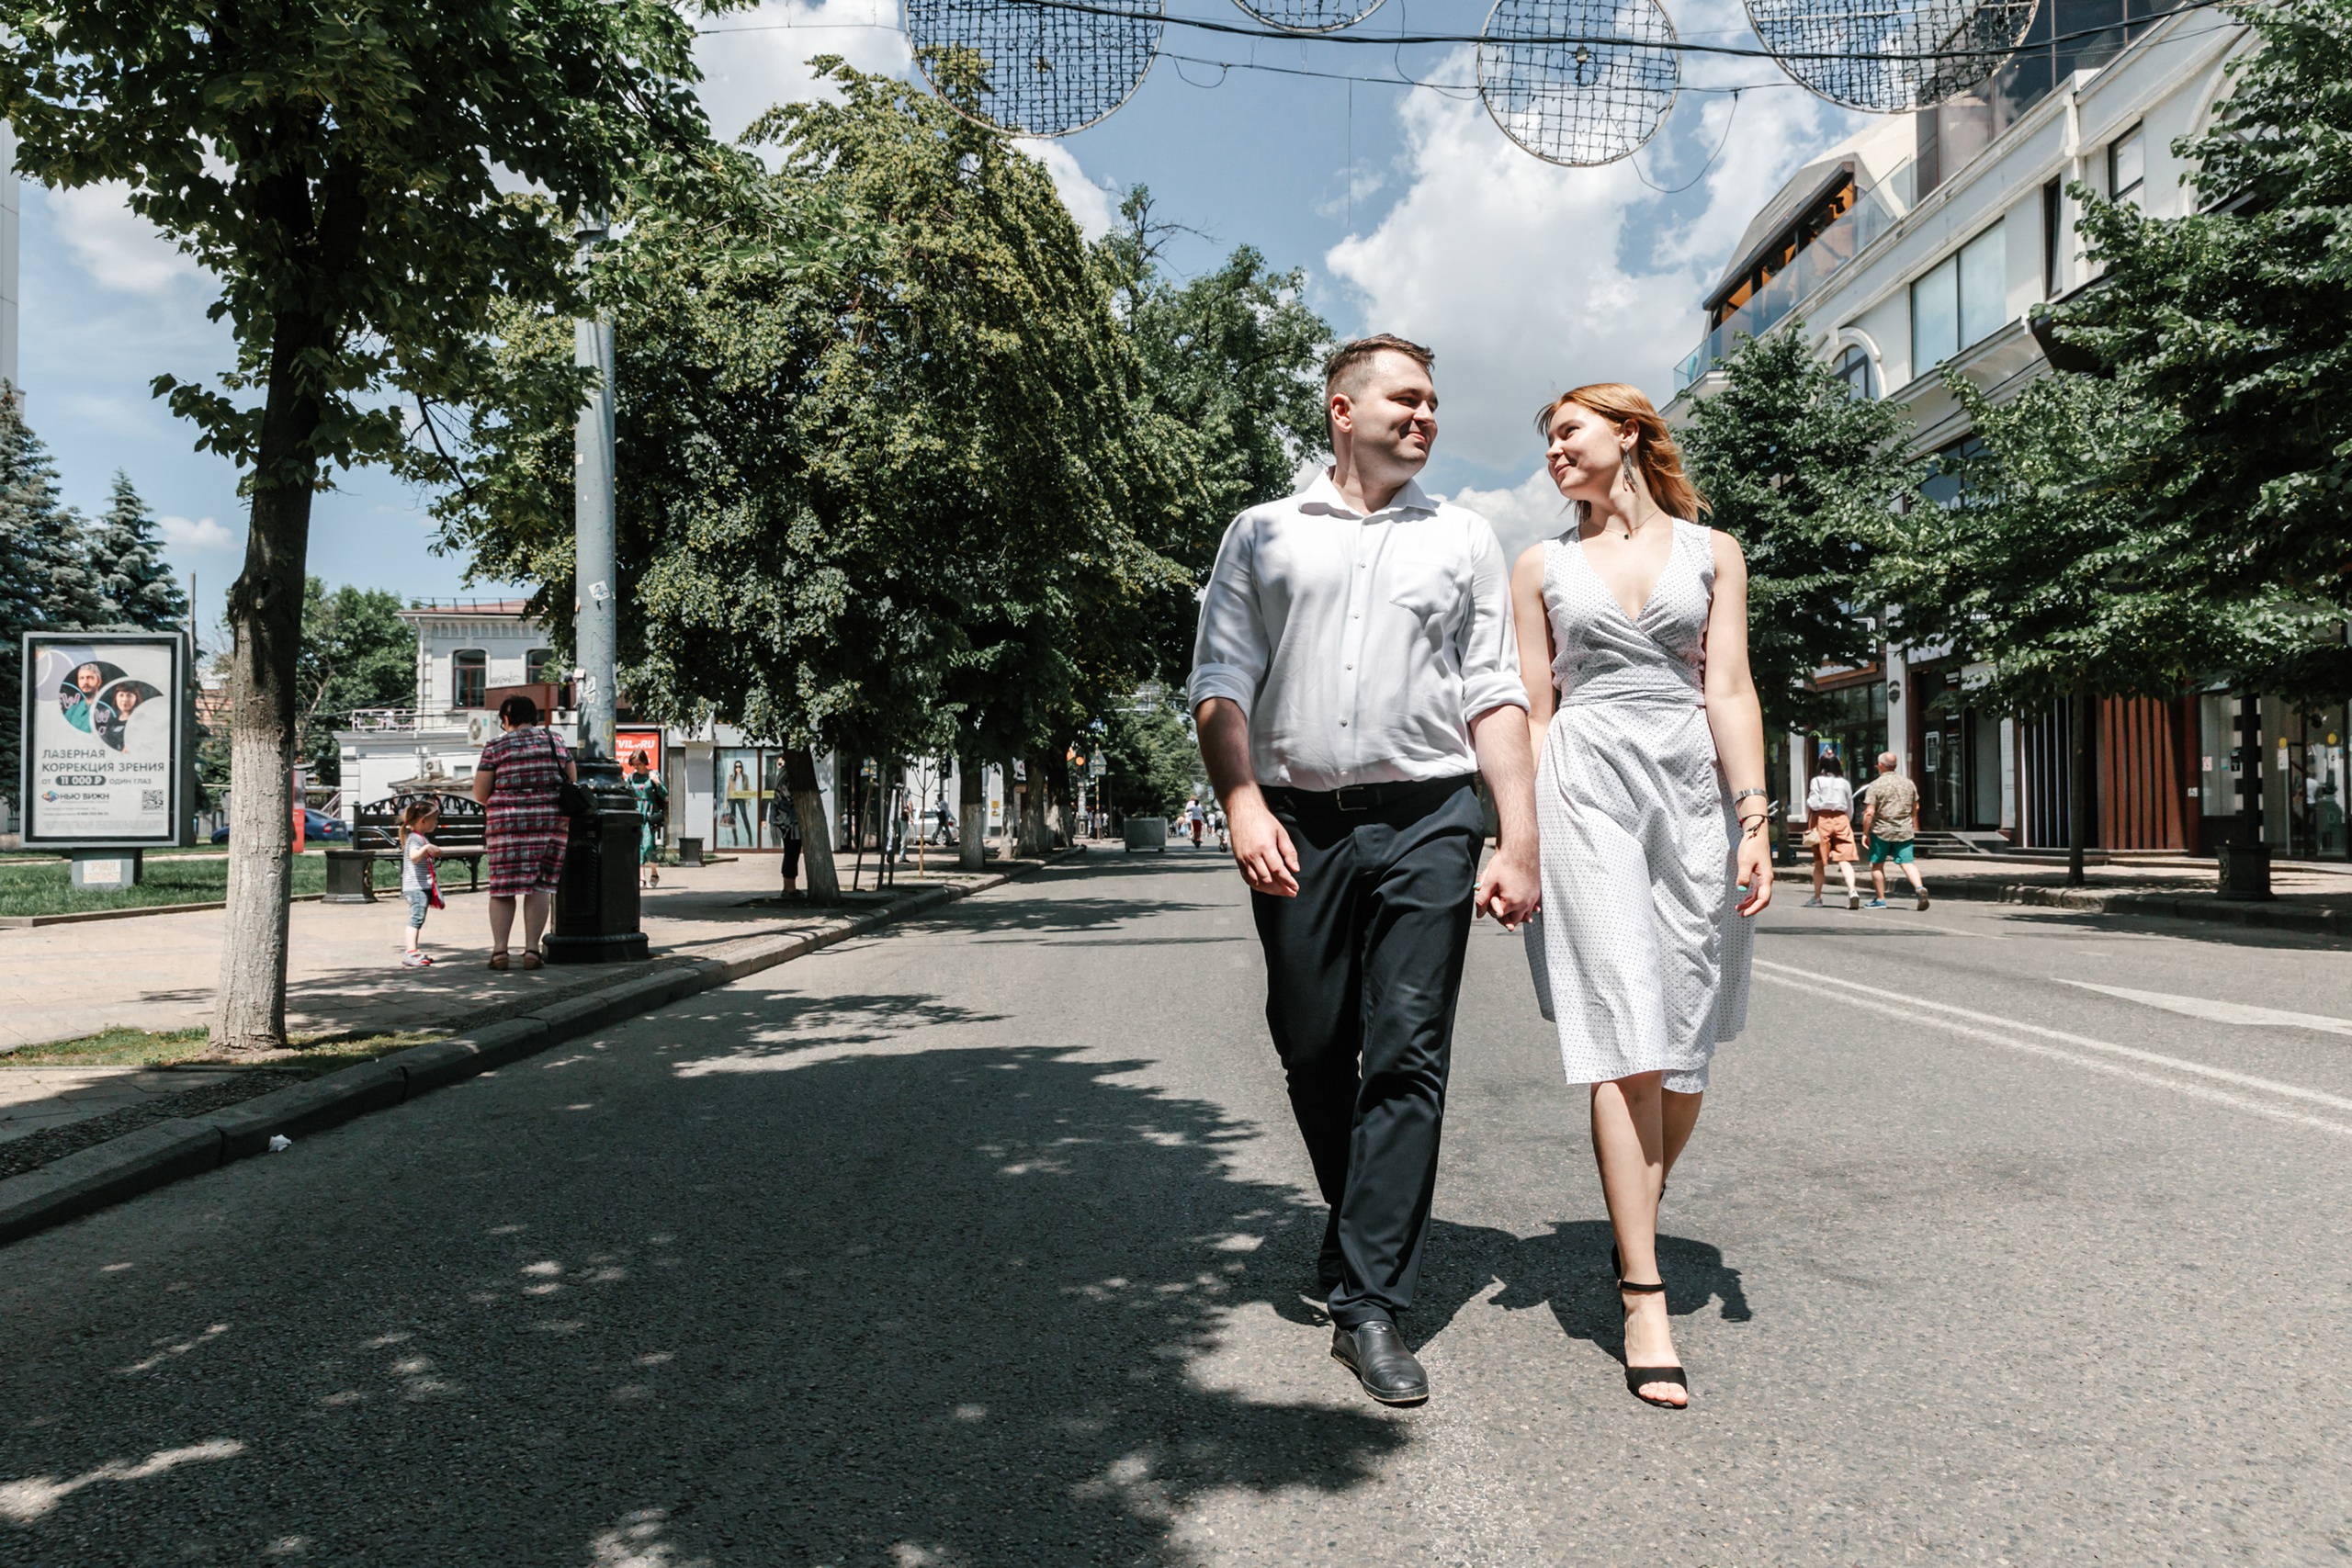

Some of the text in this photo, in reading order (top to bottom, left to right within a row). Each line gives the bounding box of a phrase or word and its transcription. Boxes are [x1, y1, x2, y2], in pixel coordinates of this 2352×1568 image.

[42, 749, 106, 759] ЛАЗЕРНАЯ
[42, 762, 165, 773] КОРРЕКЦИЯ ЗРЕНИЯ
[60, 776, 69, 784] 11
[72, 776, 92, 784] 000
